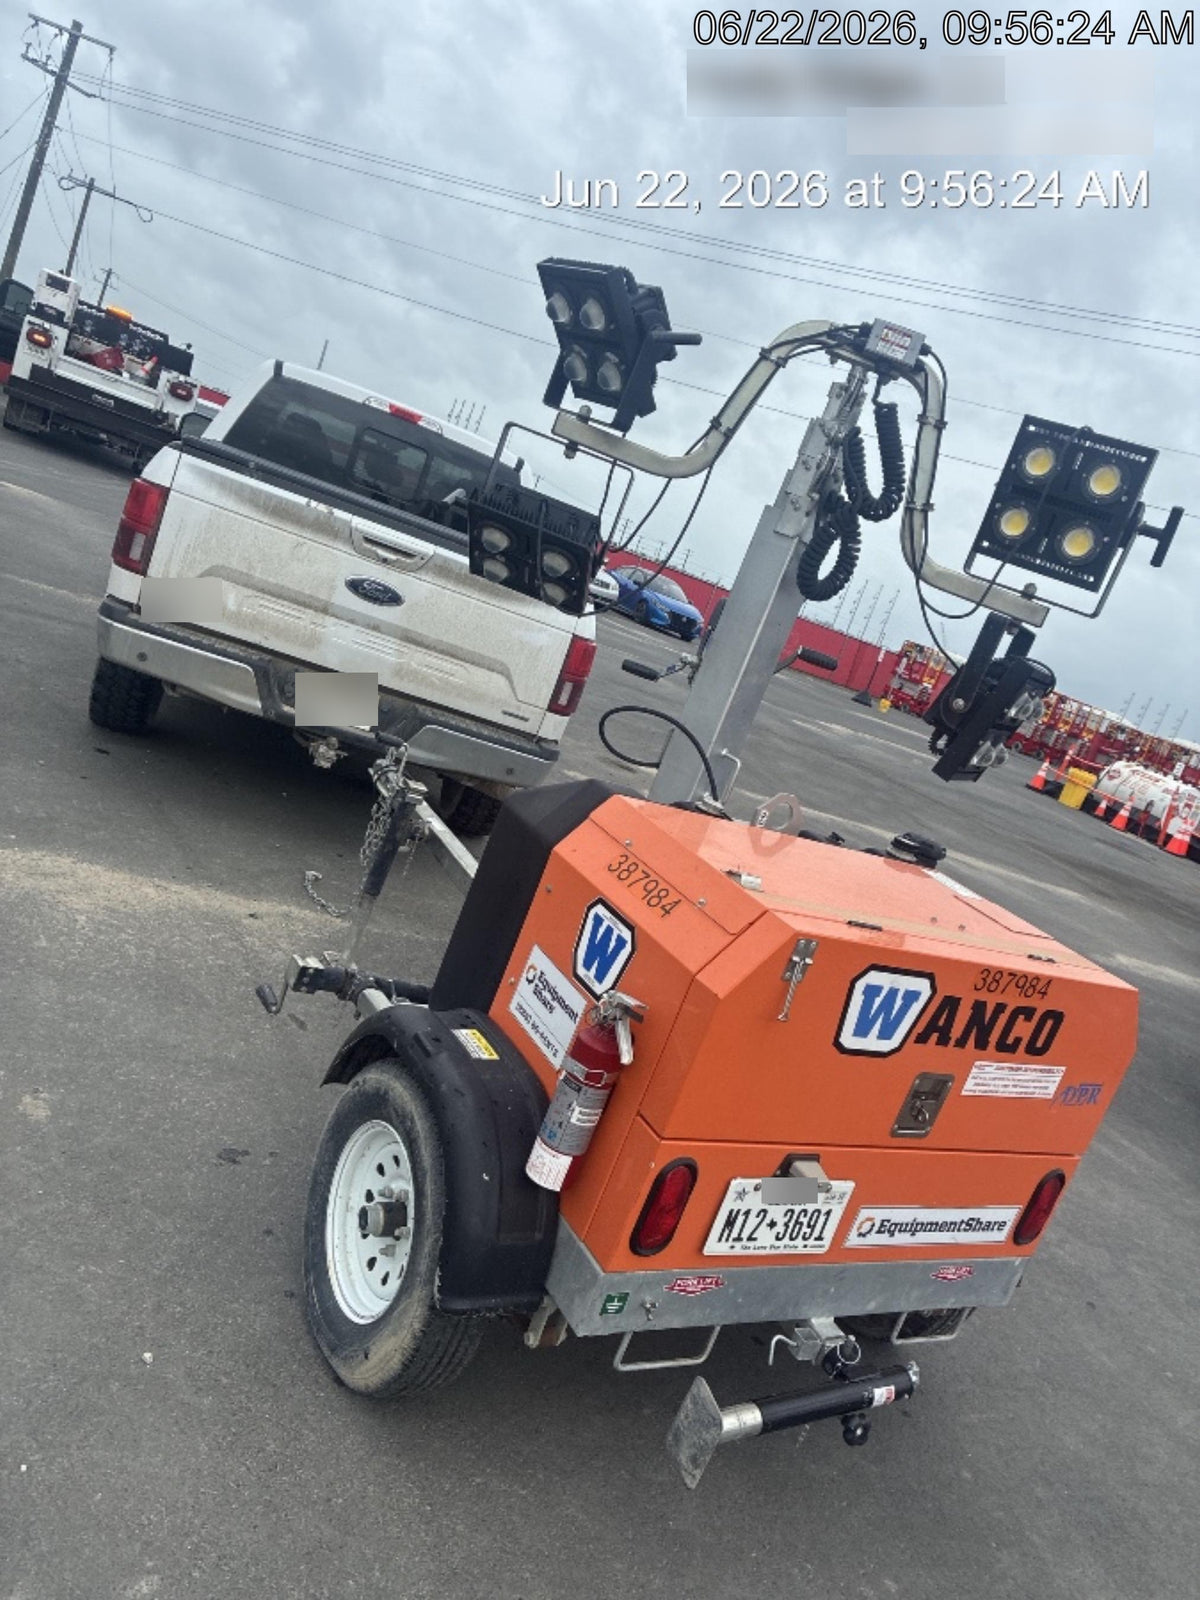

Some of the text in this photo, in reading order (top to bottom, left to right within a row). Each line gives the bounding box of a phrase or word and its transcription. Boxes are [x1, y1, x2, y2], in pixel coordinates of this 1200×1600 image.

[607, 854, 682, 918] 387984
[973, 968, 1053, 1000] 387984
[845, 976, 1065, 1057] WANCO
[874, 1217, 1008, 1238] EquipmentShare
